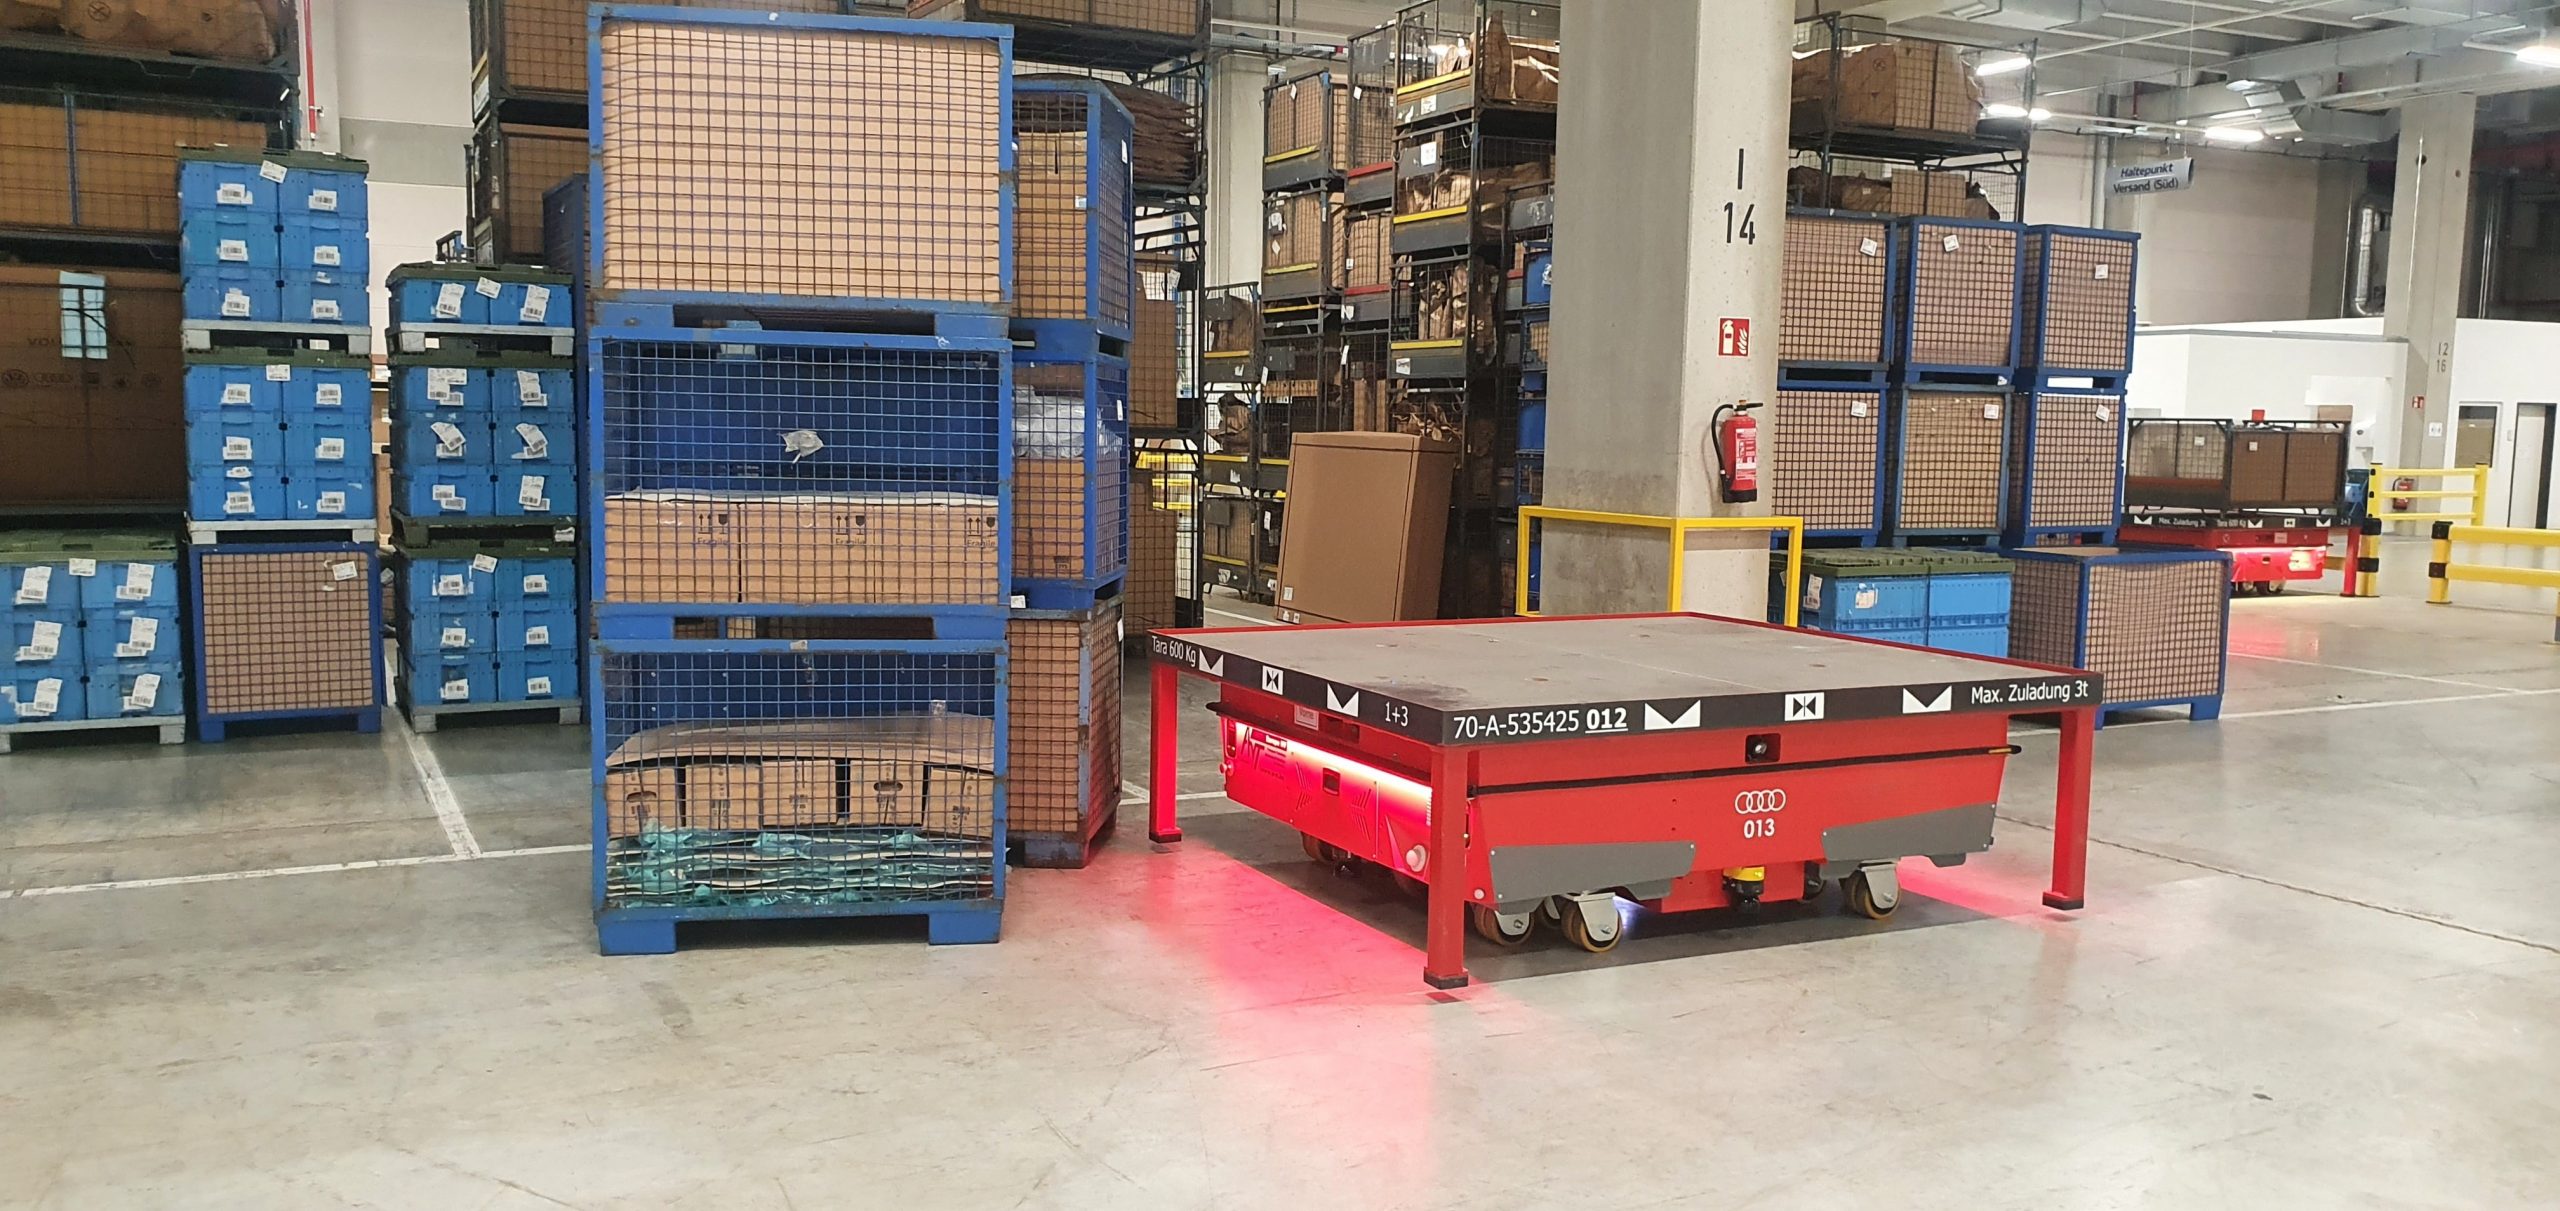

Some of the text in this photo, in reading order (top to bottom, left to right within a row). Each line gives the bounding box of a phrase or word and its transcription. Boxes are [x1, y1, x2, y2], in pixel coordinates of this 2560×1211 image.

[2120, 162, 2175, 179] Haltepunkt
[2113, 176, 2179, 194] Versand (Süd)
[1723, 201, 1756, 245] 14
[2437, 359, 2447, 373] 16
[1151, 635, 1196, 668] Tara 600 Kg
[1971, 679, 2089, 704] Max. Zuladung 3t
[1384, 701, 1409, 727] 1+3
[1453, 707, 1628, 739] 70-A-535425 012
[1743, 817, 1775, 839] 013
